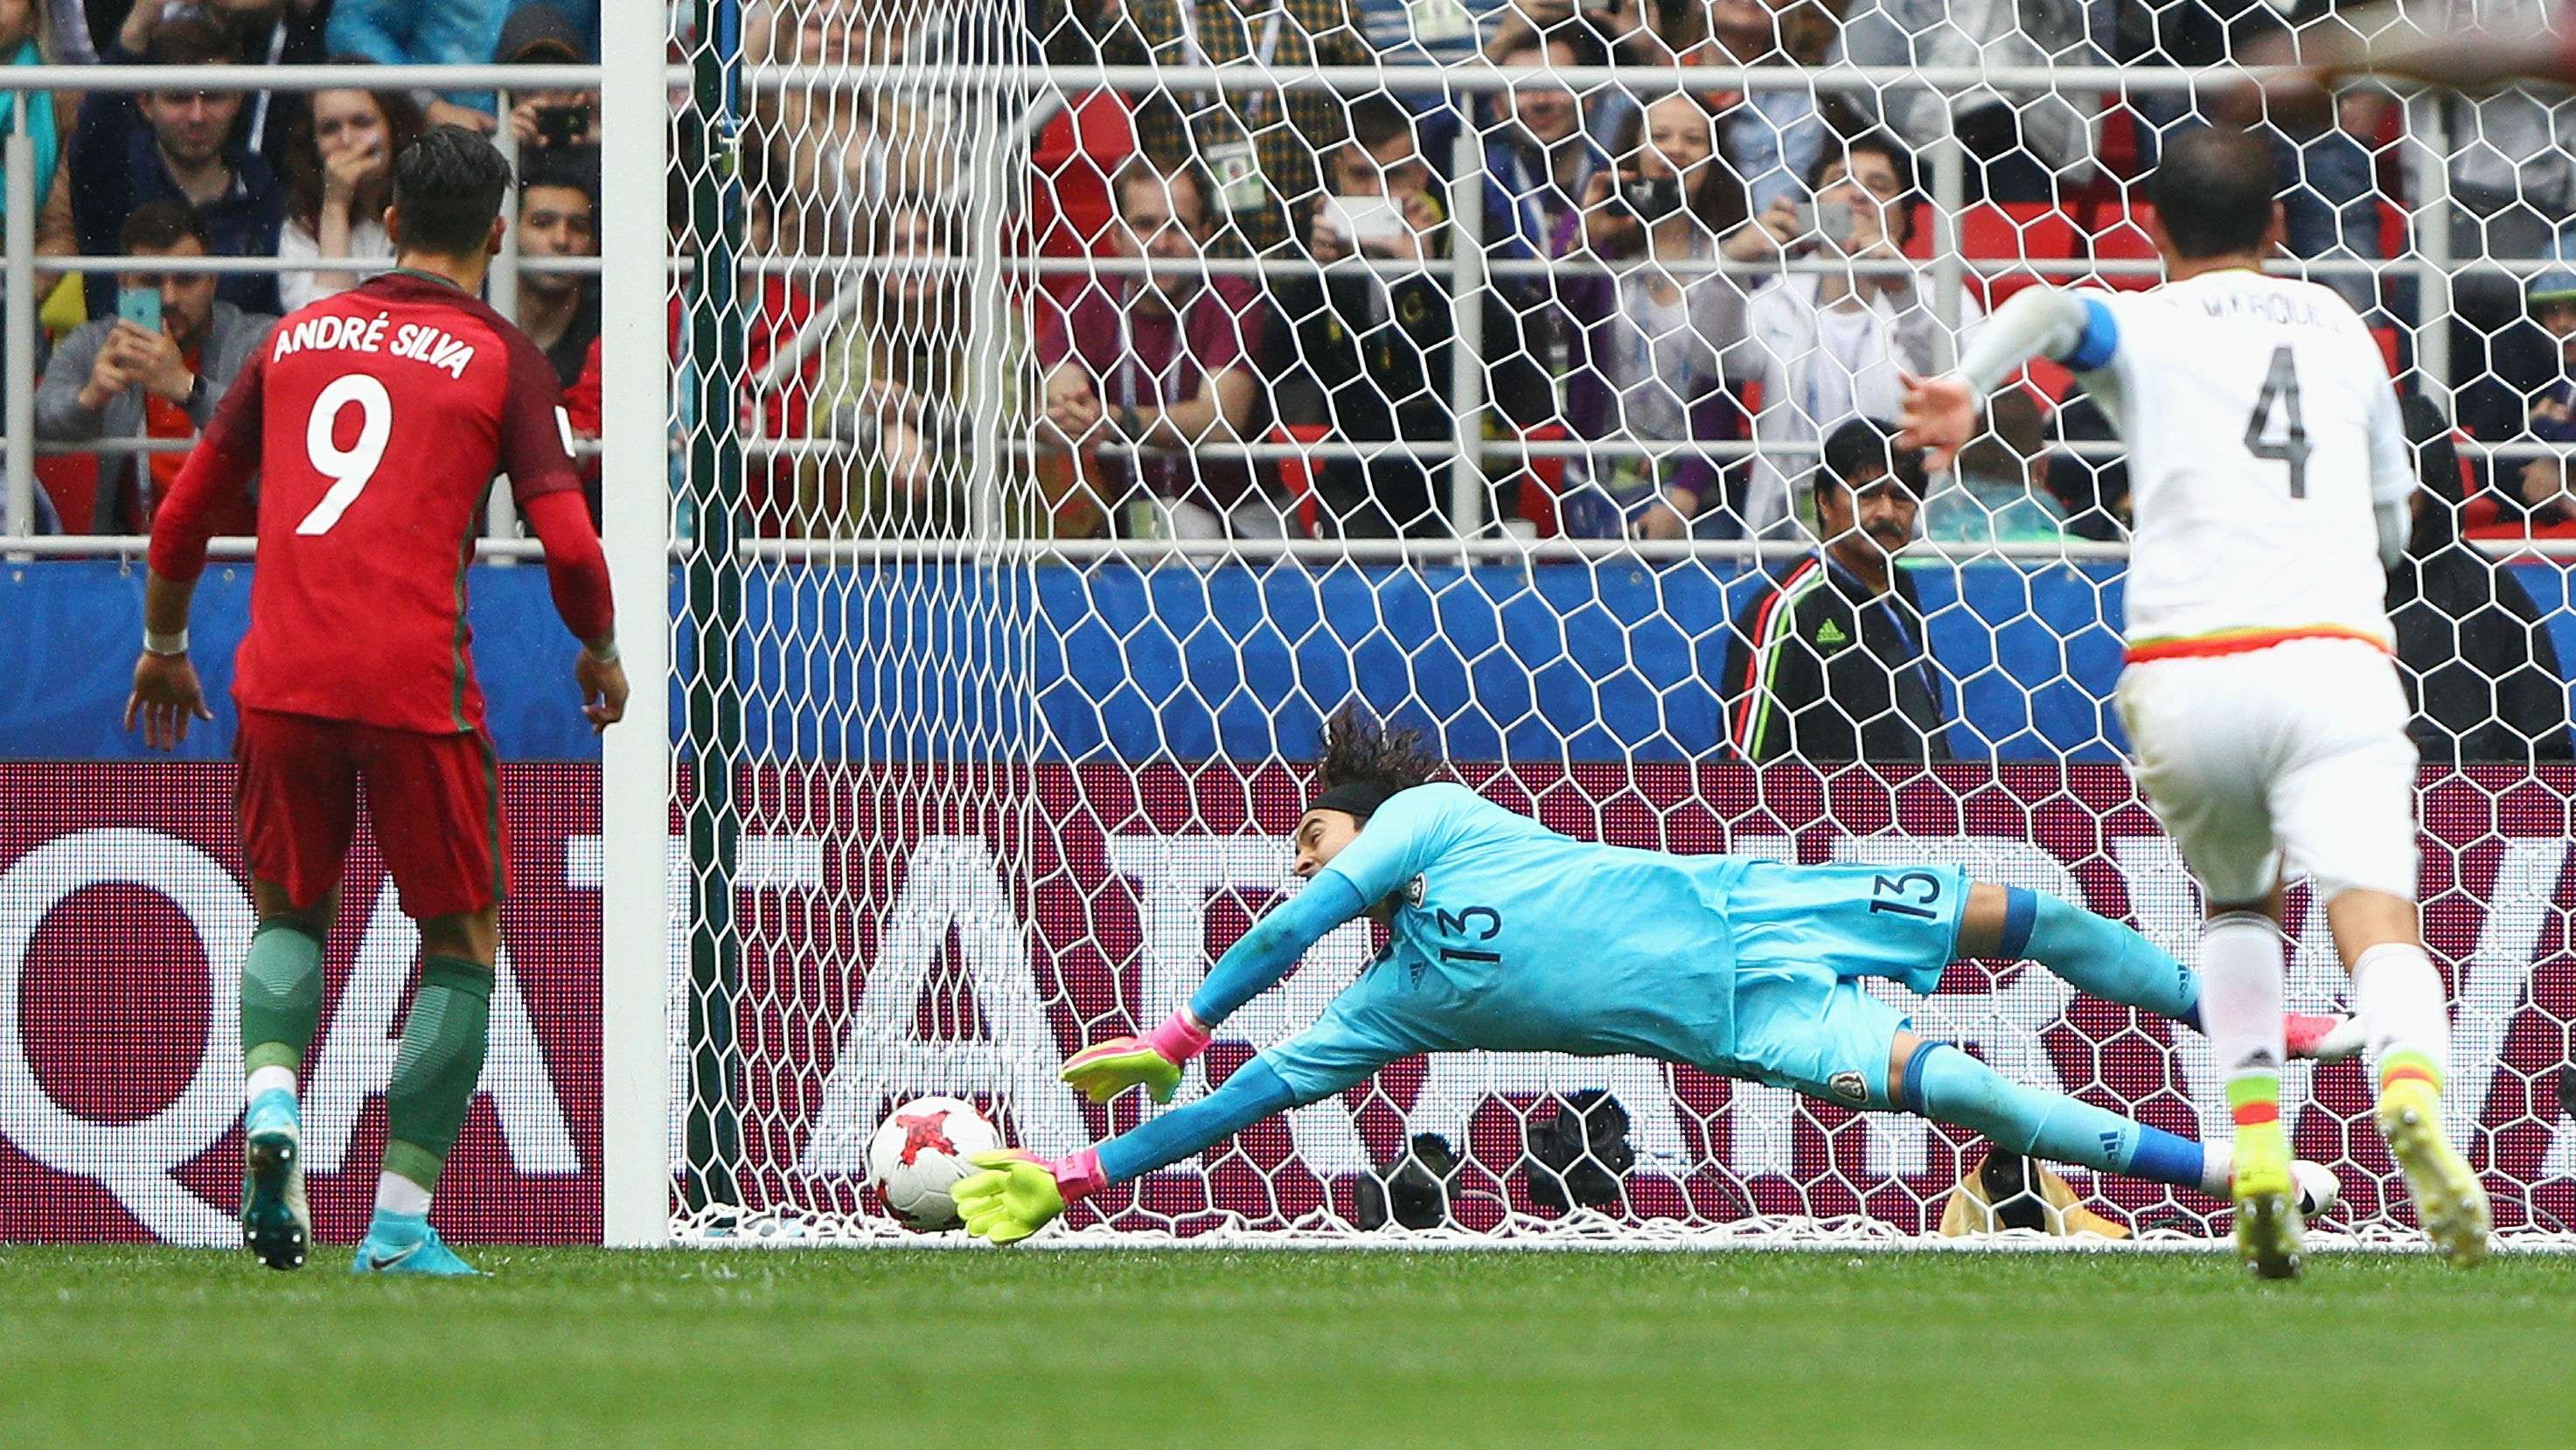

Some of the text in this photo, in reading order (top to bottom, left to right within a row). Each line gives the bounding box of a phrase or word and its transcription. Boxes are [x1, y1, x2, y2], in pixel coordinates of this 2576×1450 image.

[273, 311, 475, 379] ANDRÉ SILVA
[295, 373, 393, 536] 9
[2245, 346, 2312, 498] 4
[1869, 872, 1940, 920] 13
[1436, 905, 1502, 964] 13
